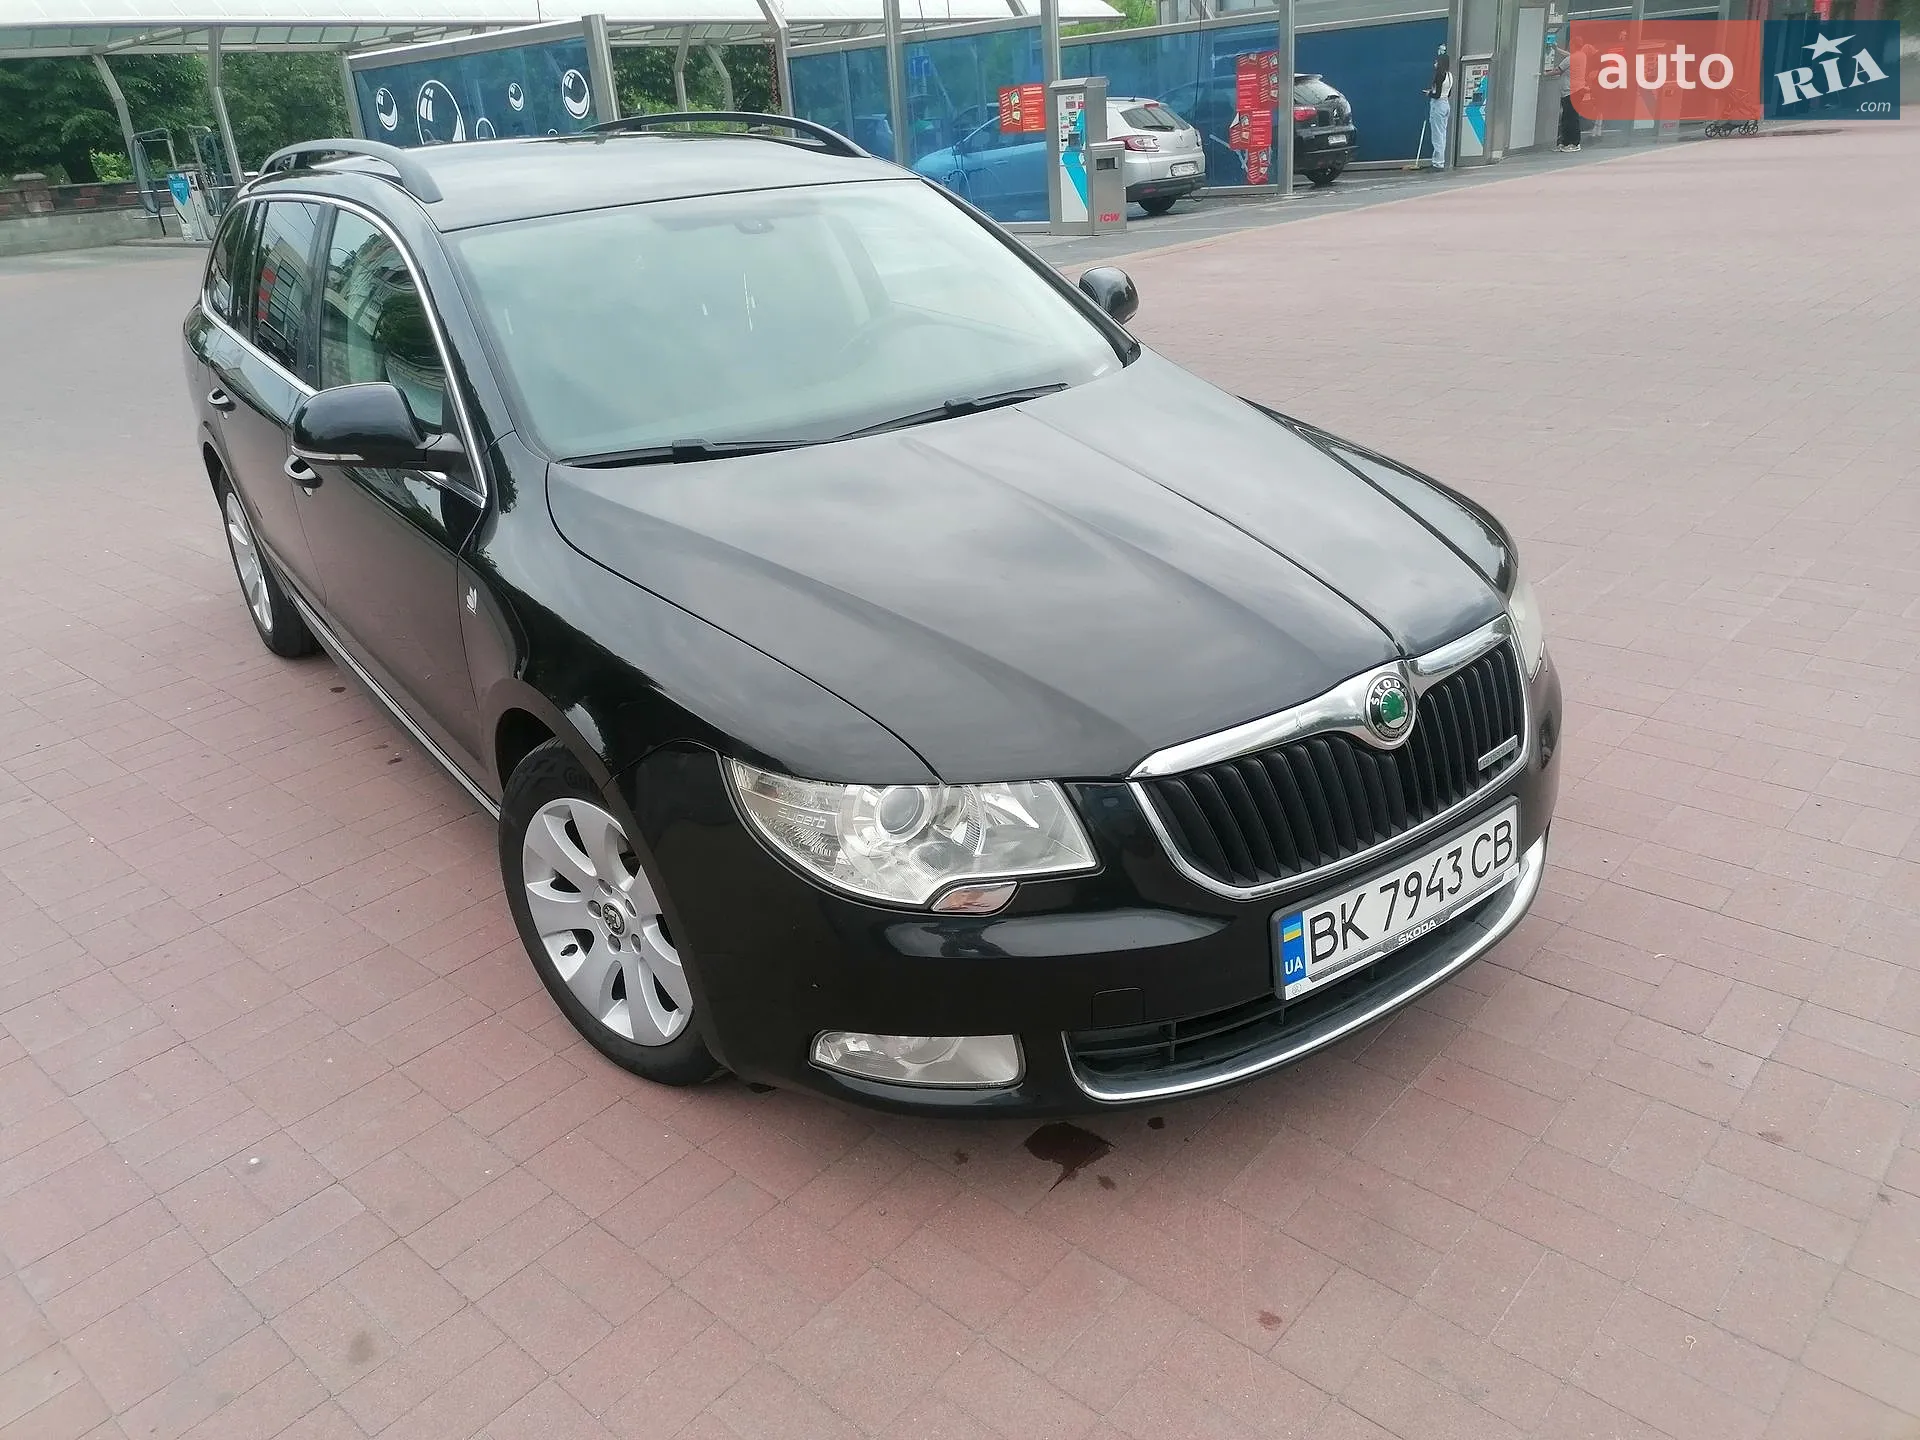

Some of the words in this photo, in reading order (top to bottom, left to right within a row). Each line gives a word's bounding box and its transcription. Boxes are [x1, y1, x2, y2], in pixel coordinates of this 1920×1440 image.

[1099, 213, 1120, 222] ICW
[1308, 893, 1370, 965] BK
[1379, 846, 1463, 932] 7943
[1471, 819, 1513, 879] CB
[1285, 956, 1303, 975] UA
